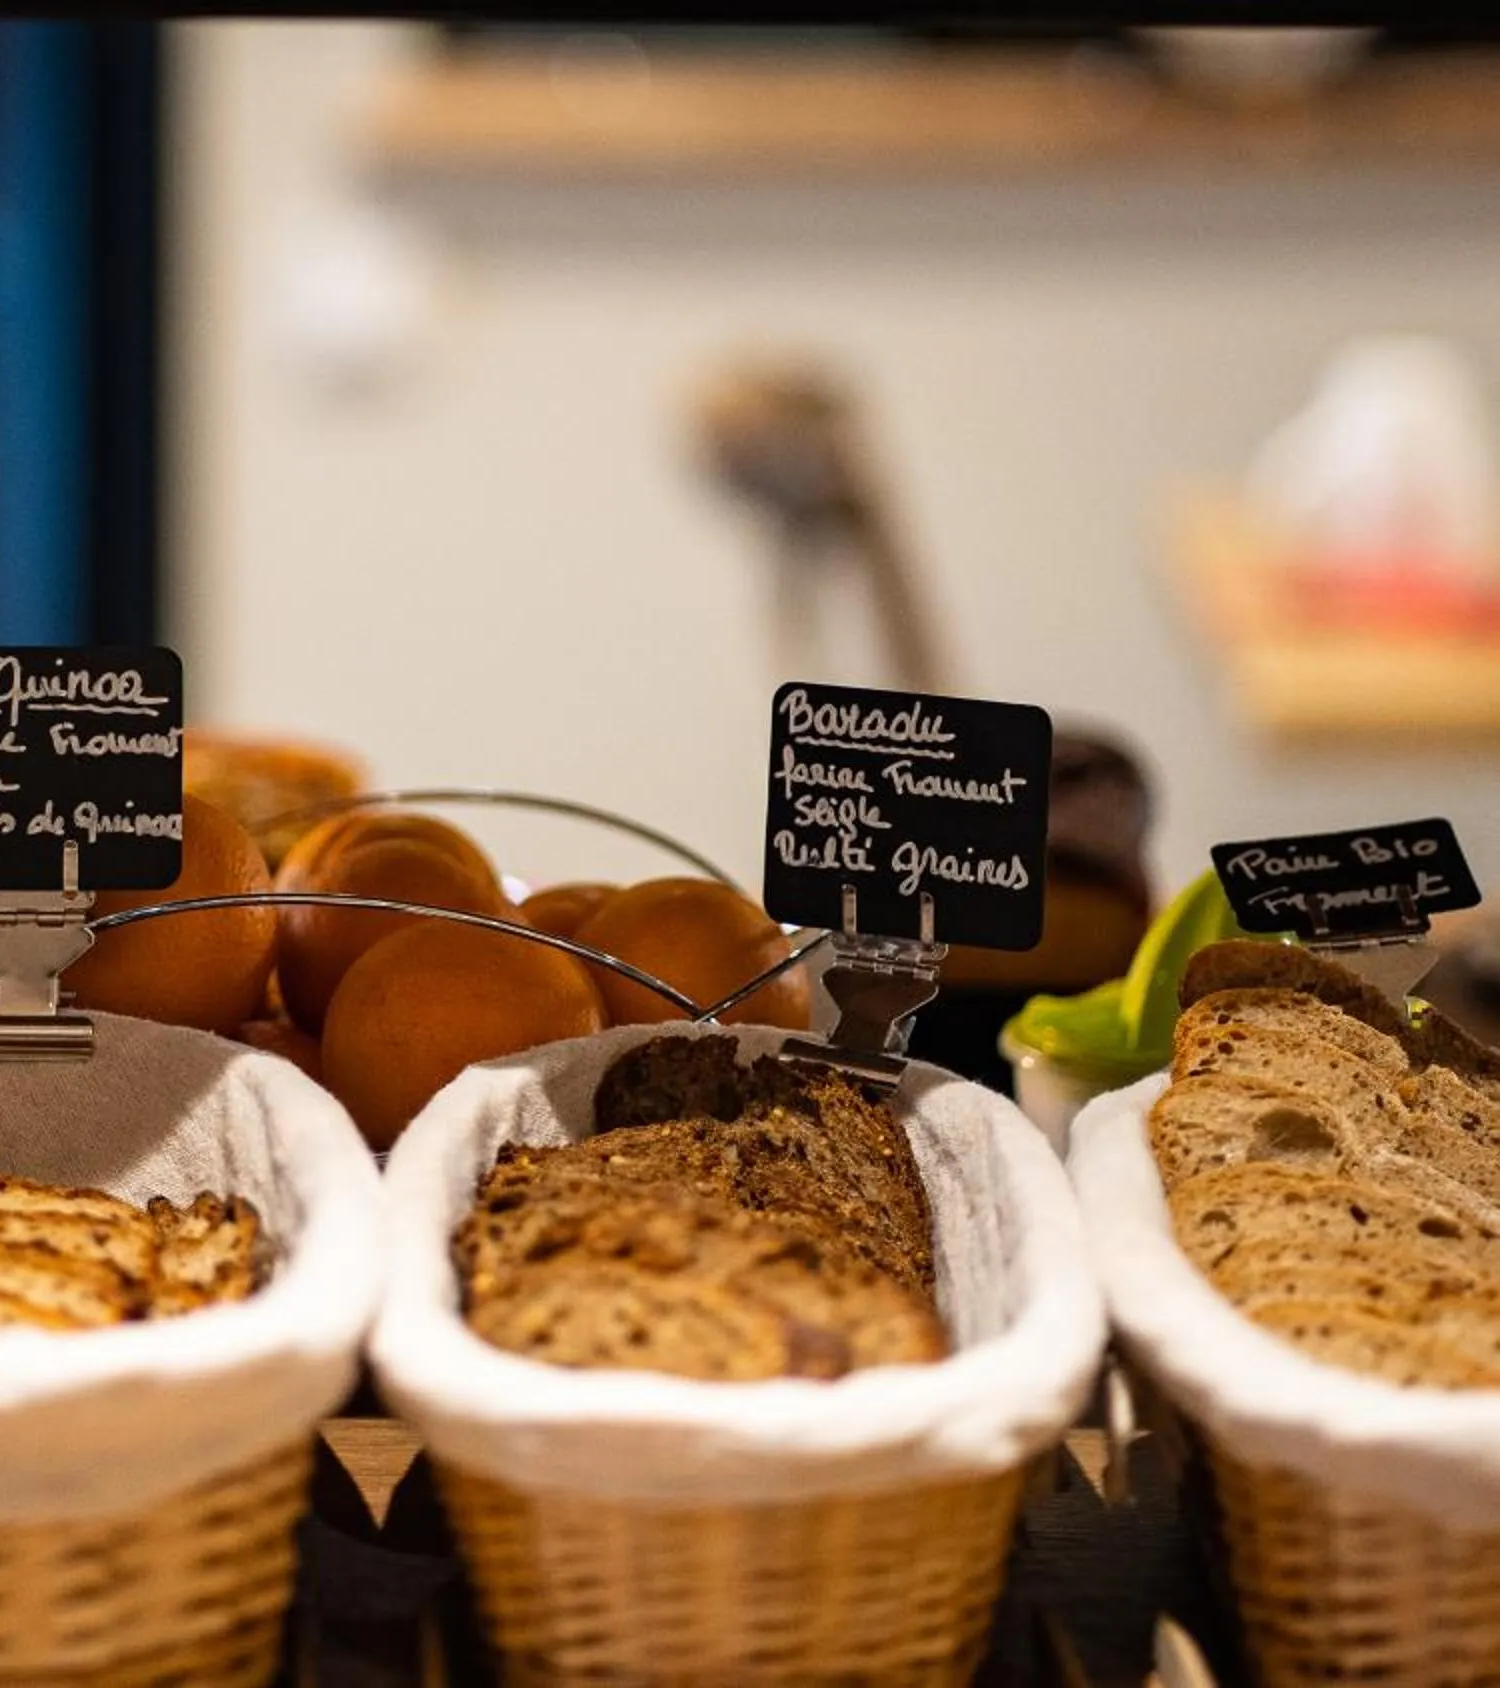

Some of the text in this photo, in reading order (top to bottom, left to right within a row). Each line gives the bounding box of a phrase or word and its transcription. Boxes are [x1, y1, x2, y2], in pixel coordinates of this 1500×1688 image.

[27, 800, 65, 836] de
[891, 841, 1029, 897] graines
[1227, 846, 1340, 880] Pain
